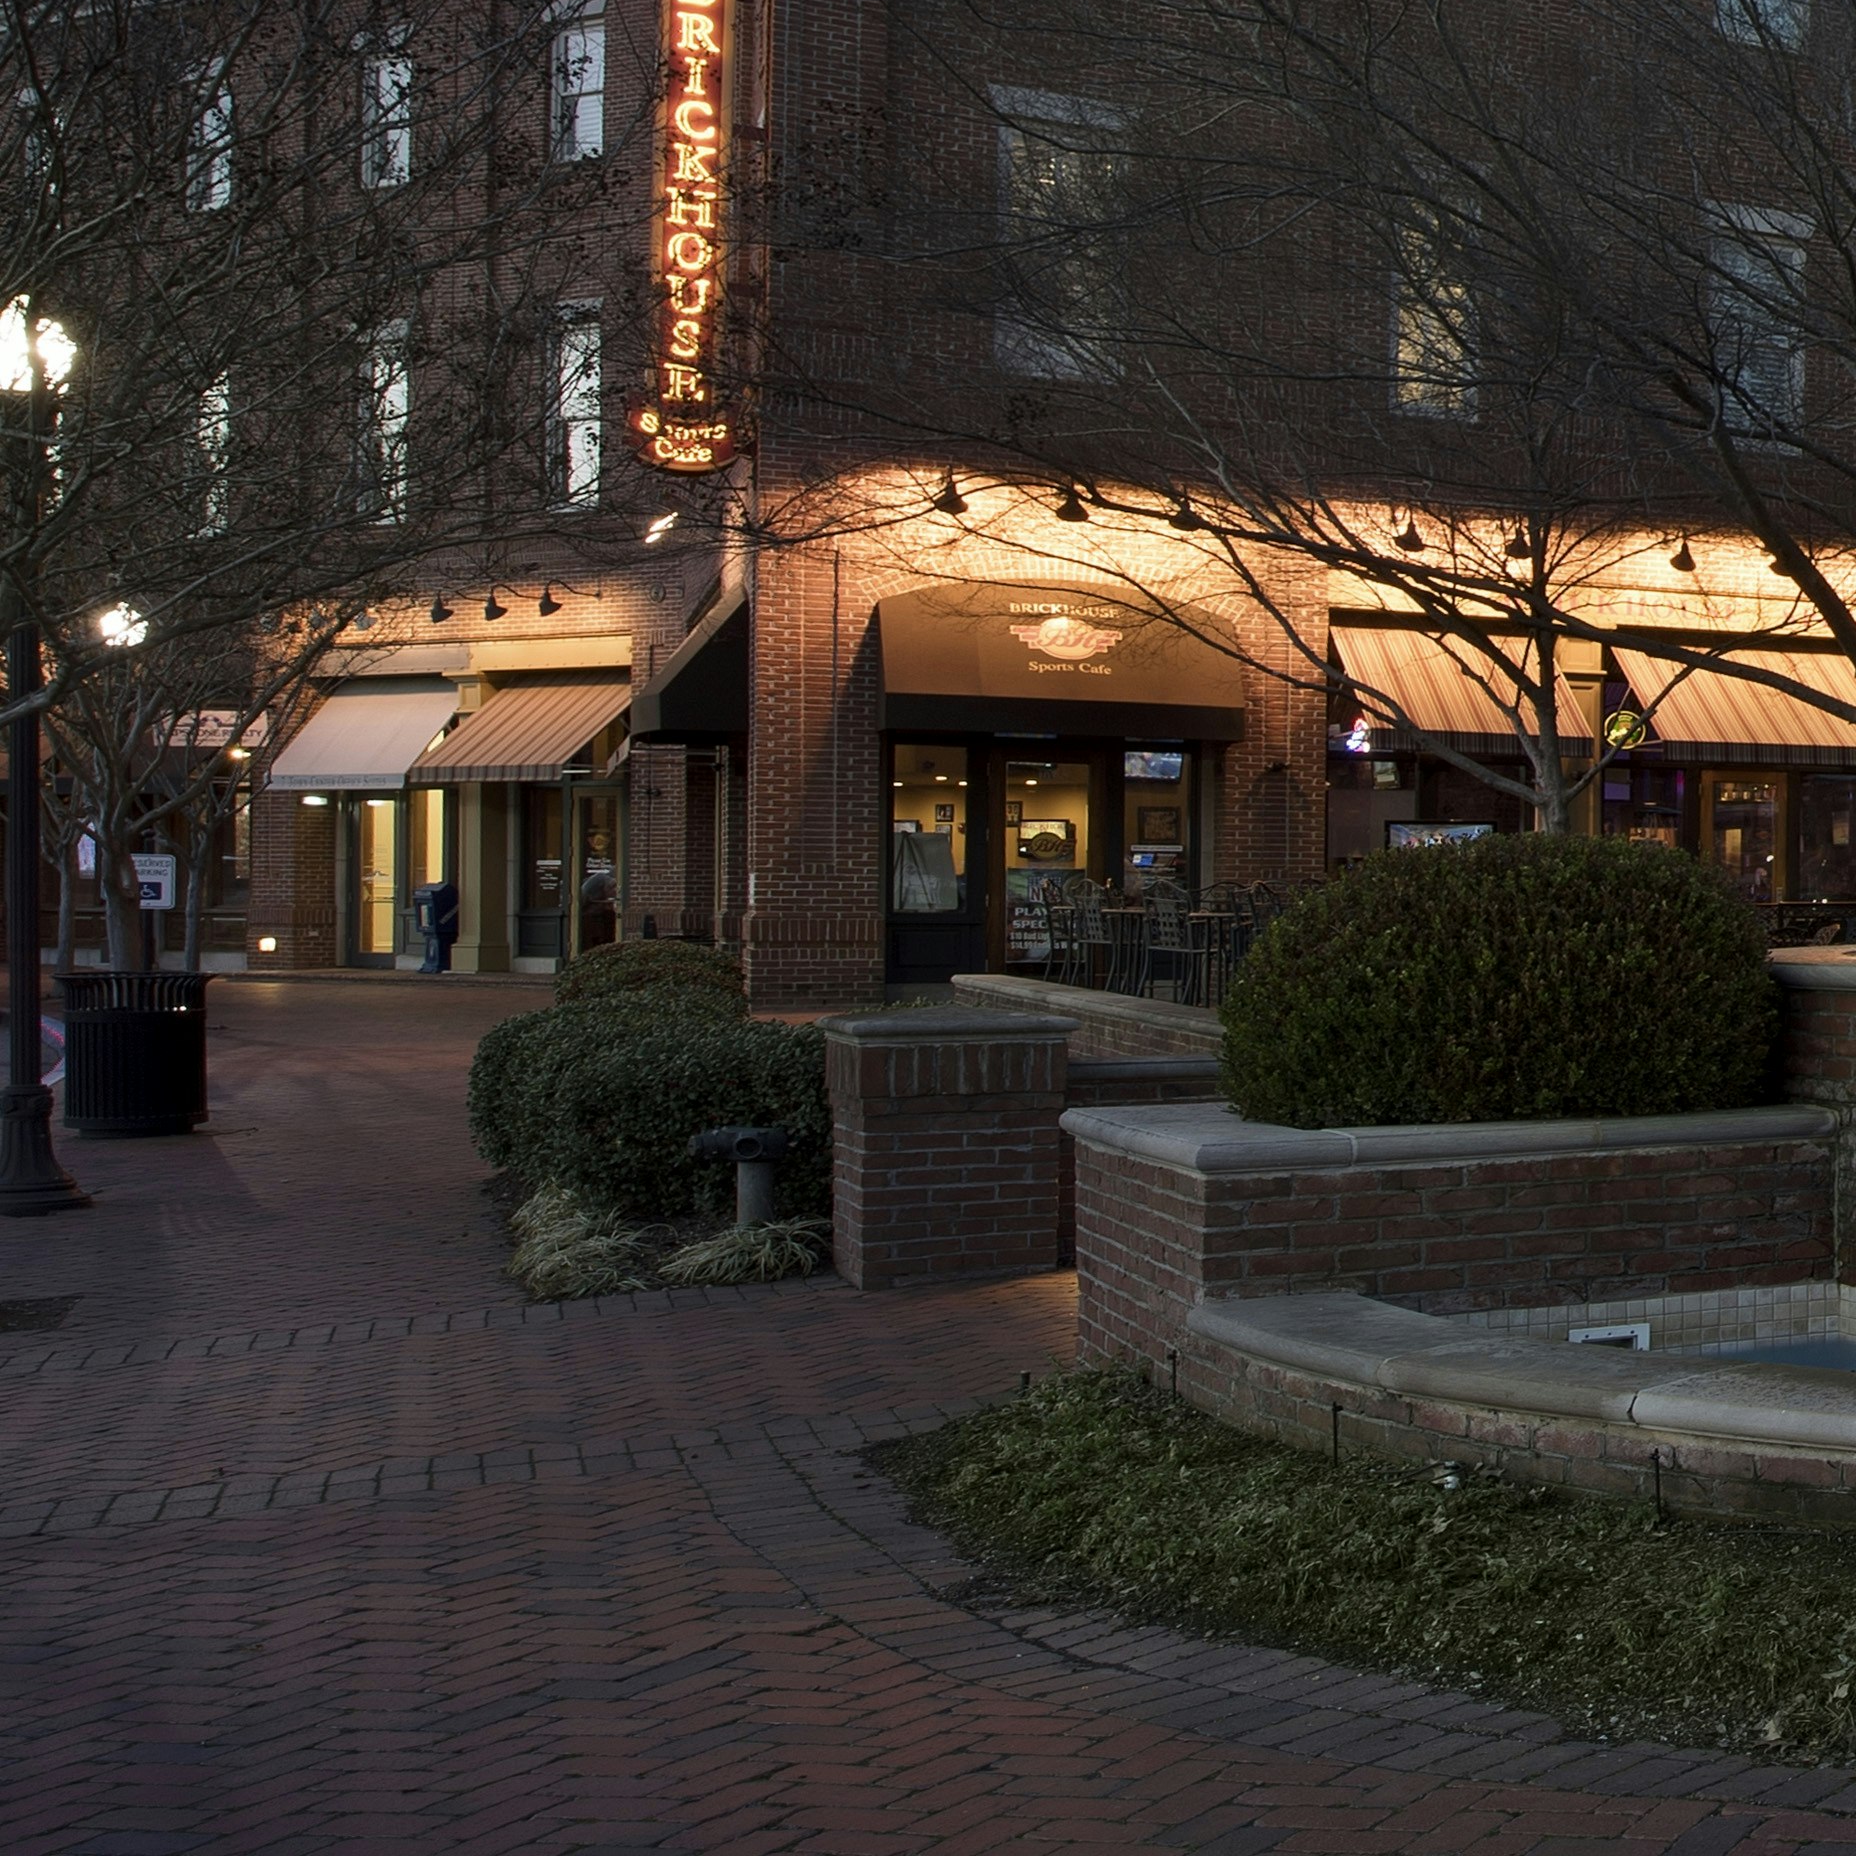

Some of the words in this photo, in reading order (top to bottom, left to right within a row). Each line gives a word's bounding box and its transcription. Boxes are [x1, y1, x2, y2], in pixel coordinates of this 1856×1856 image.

[640, 413, 728, 441] Sorts
[1009, 602, 1121, 619] BRICKHOUSE
[1028, 660, 1075, 674] Sports
[1078, 662, 1113, 676] Cafe
